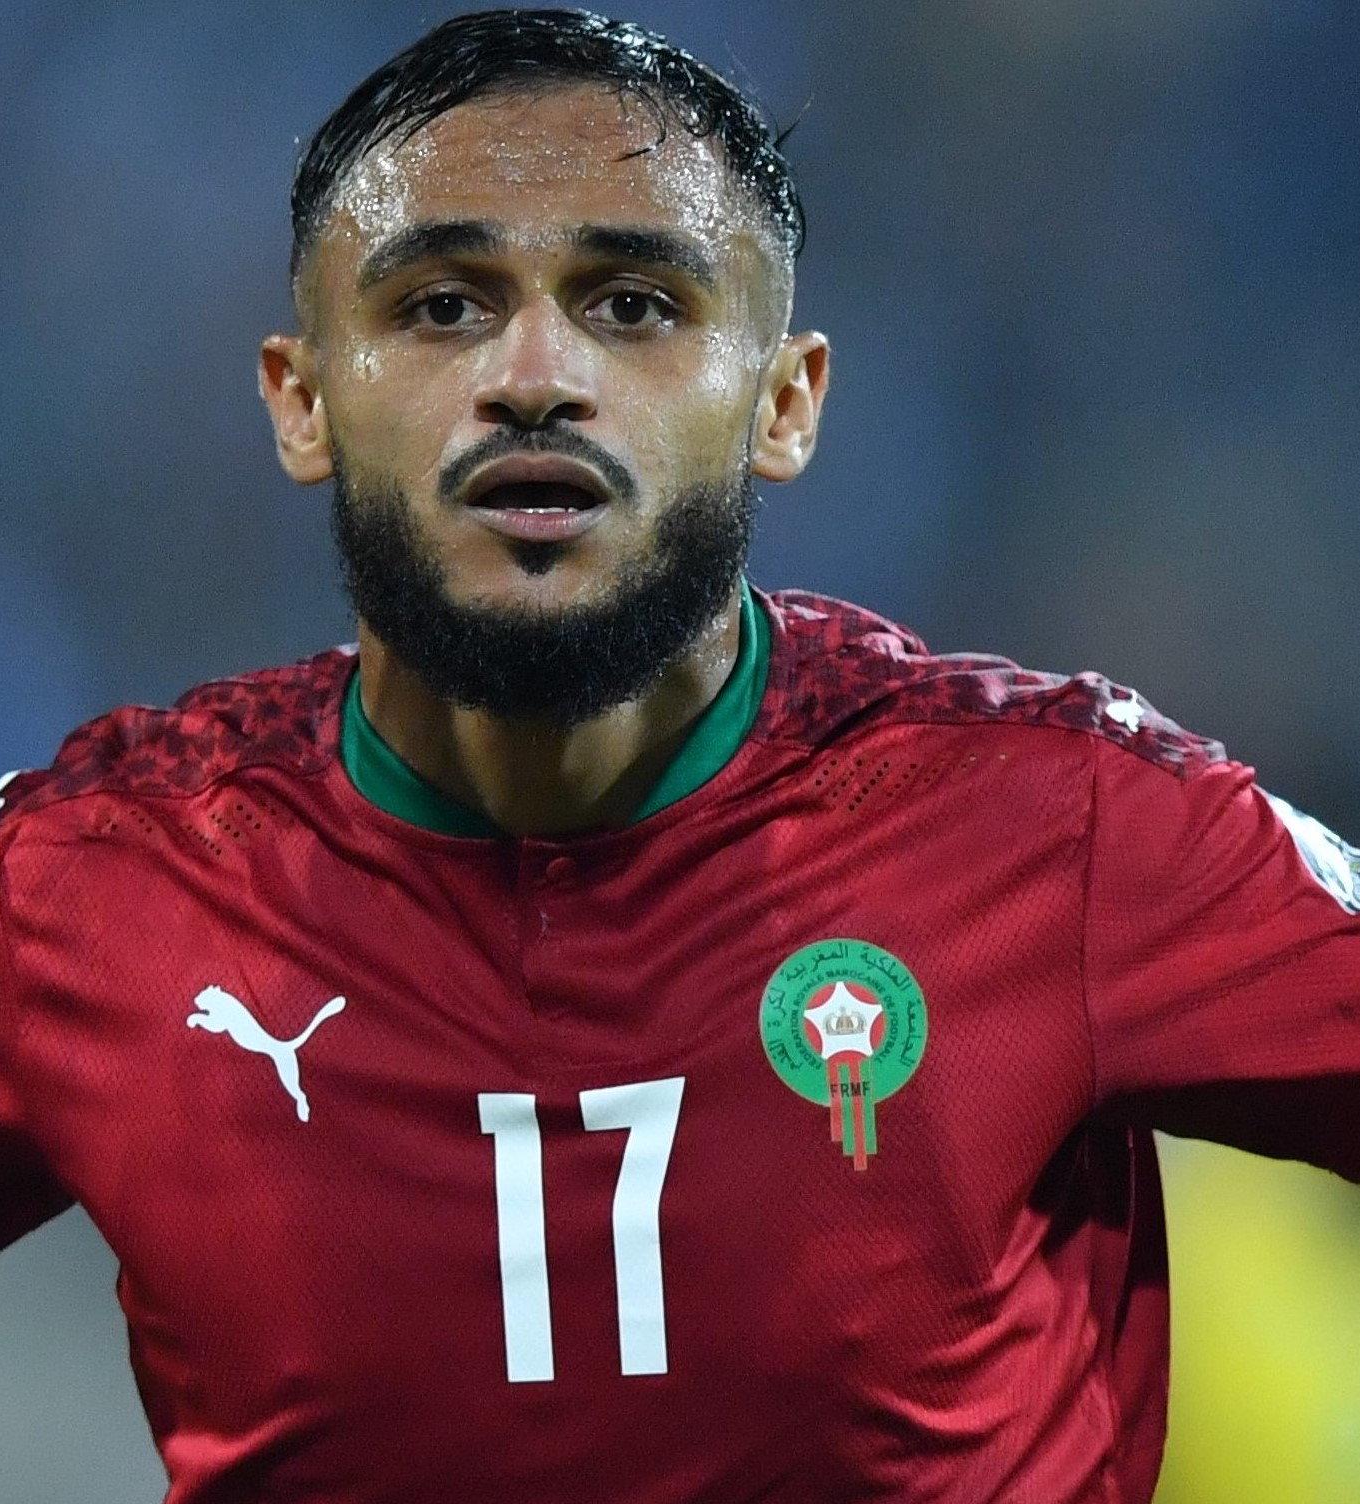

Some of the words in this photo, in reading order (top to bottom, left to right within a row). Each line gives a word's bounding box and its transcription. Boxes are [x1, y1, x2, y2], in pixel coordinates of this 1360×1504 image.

[793, 975, 825, 1006] ROYALE
[826, 969, 886, 993] MAROCAINE
[830, 1080, 871, 1098] FRMF
[477, 1076, 686, 1384] 17
